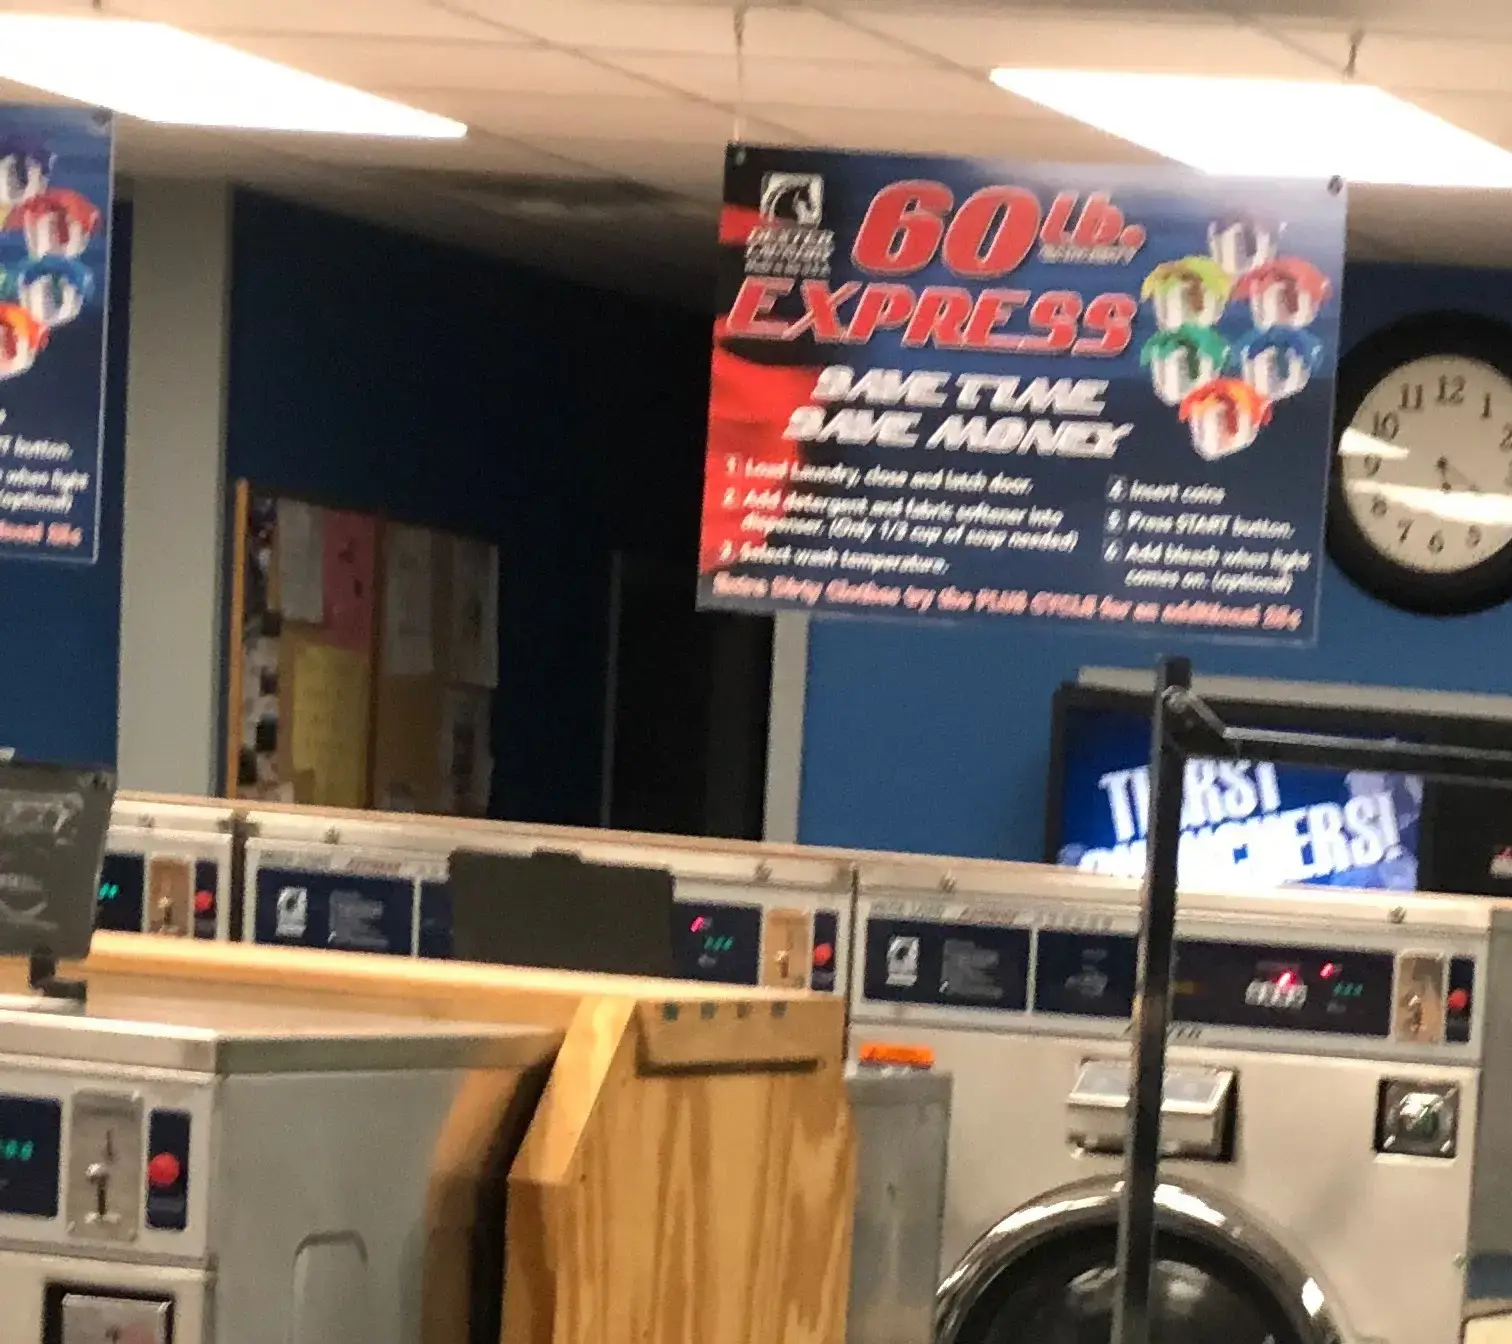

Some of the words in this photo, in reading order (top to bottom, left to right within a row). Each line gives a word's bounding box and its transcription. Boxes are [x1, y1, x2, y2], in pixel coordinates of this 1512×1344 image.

[850, 179, 1042, 279] 60
[725, 275, 1137, 356] EXPRESS
[811, 364, 951, 408] SAVE
[956, 373, 1109, 416] TIME
[1400, 382, 1424, 410] 11
[1436, 374, 1466, 405] 12
[1480, 391, 1491, 420] 1
[783, 405, 922, 448] SAVE
[925, 414, 1133, 459] MONEY
[1372, 411, 1399, 441] 10
[746, 459, 788, 480] Load
[864, 464, 907, 488] close
[911, 469, 943, 489] and
[946, 468, 987, 493] latch
[1364, 453, 1382, 476] 9
[1130, 480, 1179, 503] Insert
[744, 488, 781, 509] Add
[783, 494, 868, 518] detergent
[871, 498, 902, 519] and
[906, 498, 951, 521] fabric
[956, 501, 1026, 526] softener
[1030, 506, 1063, 529] into
[1371, 495, 1388, 517] 8
[911, 524, 942, 546] cup
[945, 523, 963, 545] of
[965, 528, 1007, 551] soap
[1128, 511, 1174, 534] Press
[1176, 512, 1232, 535] START
[1398, 519, 1414, 542] 7
[740, 543, 792, 564] Select
[794, 546, 838, 569] wash
[1428, 530, 1445, 554] 6
[1125, 542, 1163, 564] Add
[1165, 543, 1219, 566] bleach
[1222, 546, 1269, 568] when
[1270, 549, 1311, 572] light
[1125, 568, 1180, 589] comes
[1212, 570, 1294, 594] (optional)
[1133, 601, 1160, 623] an
[1100, 756, 1280, 842] TRST
